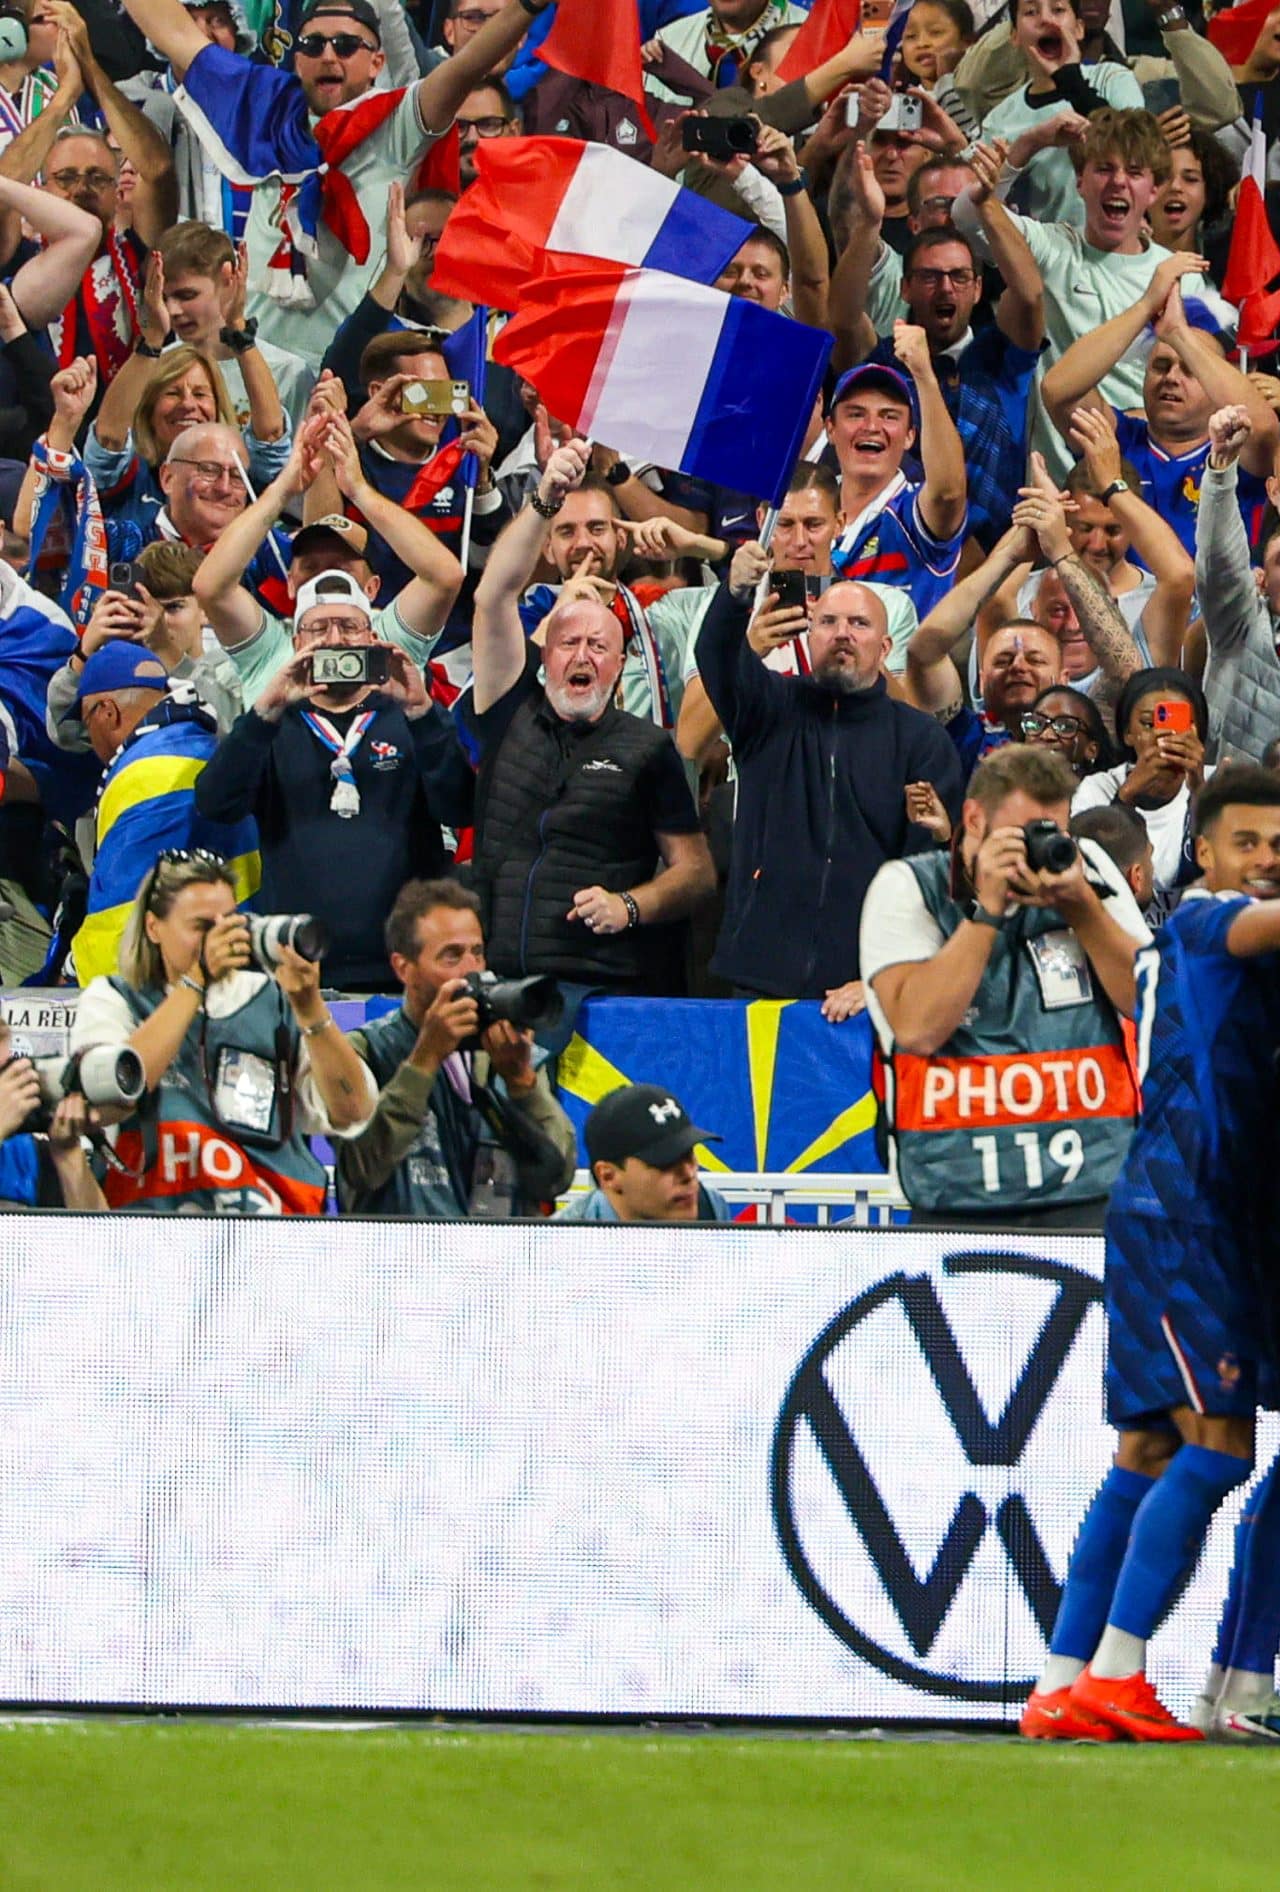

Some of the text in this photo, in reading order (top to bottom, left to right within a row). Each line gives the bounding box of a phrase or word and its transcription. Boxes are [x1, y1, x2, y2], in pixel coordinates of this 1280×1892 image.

[7, 1009, 30, 1028] LA
[922, 1056, 1107, 1119] PHOTO
[972, 1128, 1085, 1193] 119
